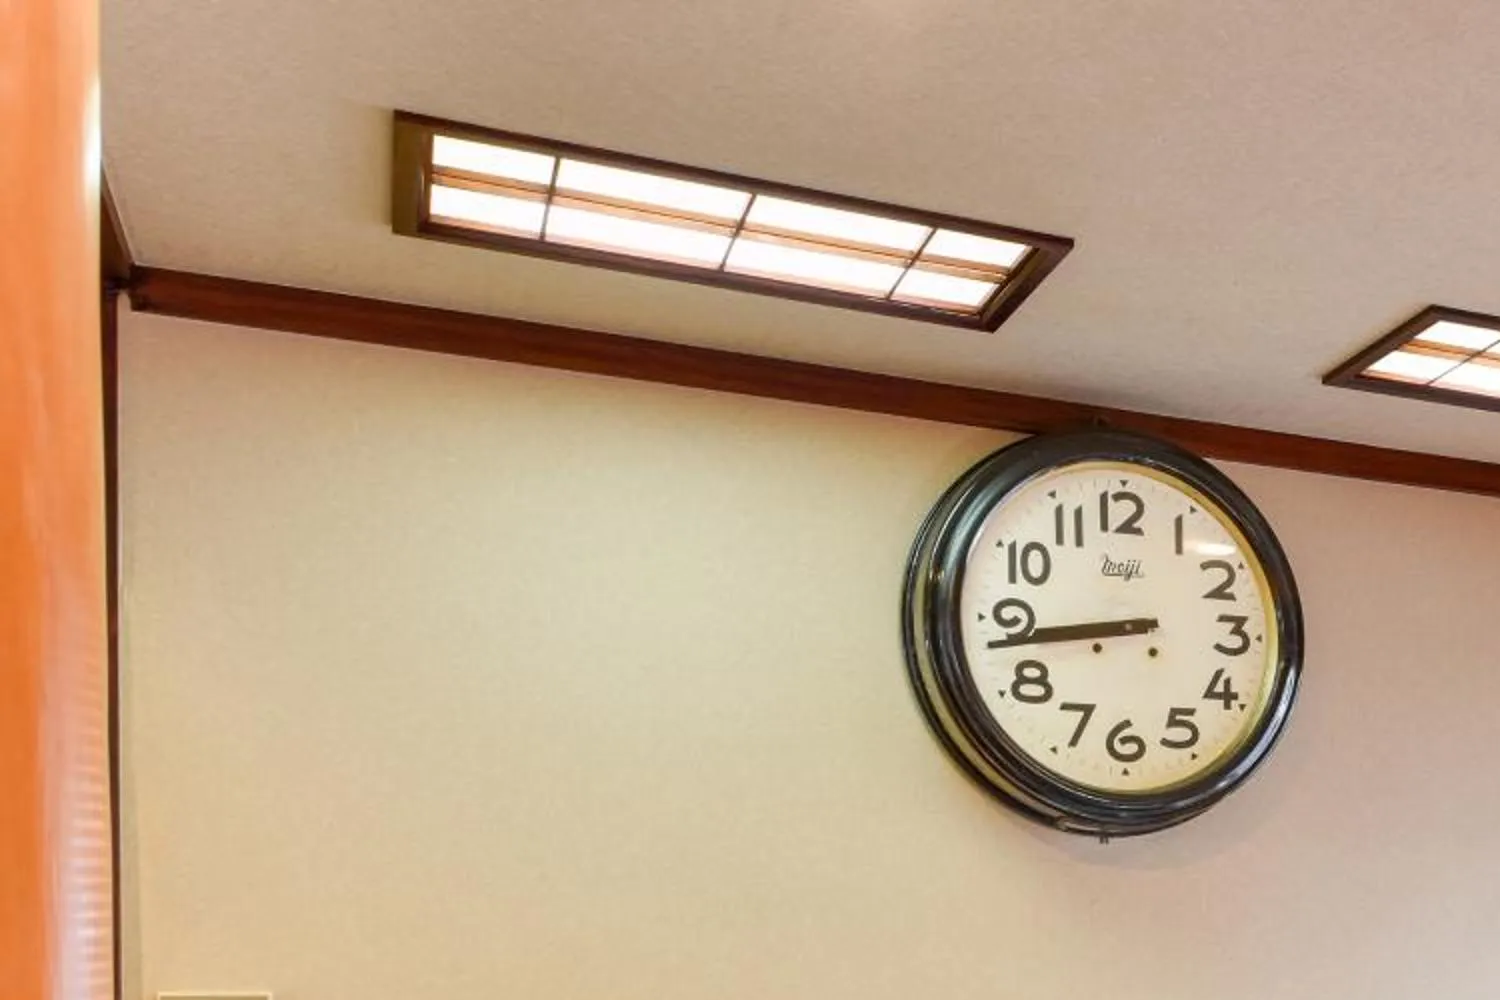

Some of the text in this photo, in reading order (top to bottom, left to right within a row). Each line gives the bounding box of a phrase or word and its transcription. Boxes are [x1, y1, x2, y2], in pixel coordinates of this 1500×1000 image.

[1054, 503, 1084, 548] 11
[1099, 490, 1145, 536] 12
[1174, 513, 1184, 555] 1
[1007, 540, 1051, 585] 10
[1199, 559, 1237, 601] 2
[992, 598, 1036, 641] 9
[1213, 614, 1251, 657] 3
[1010, 659, 1054, 704] 8
[1202, 668, 1239, 711] 4
[1059, 702, 1096, 748] 7
[1105, 719, 1147, 763] 6
[1159, 707, 1200, 749] 5
